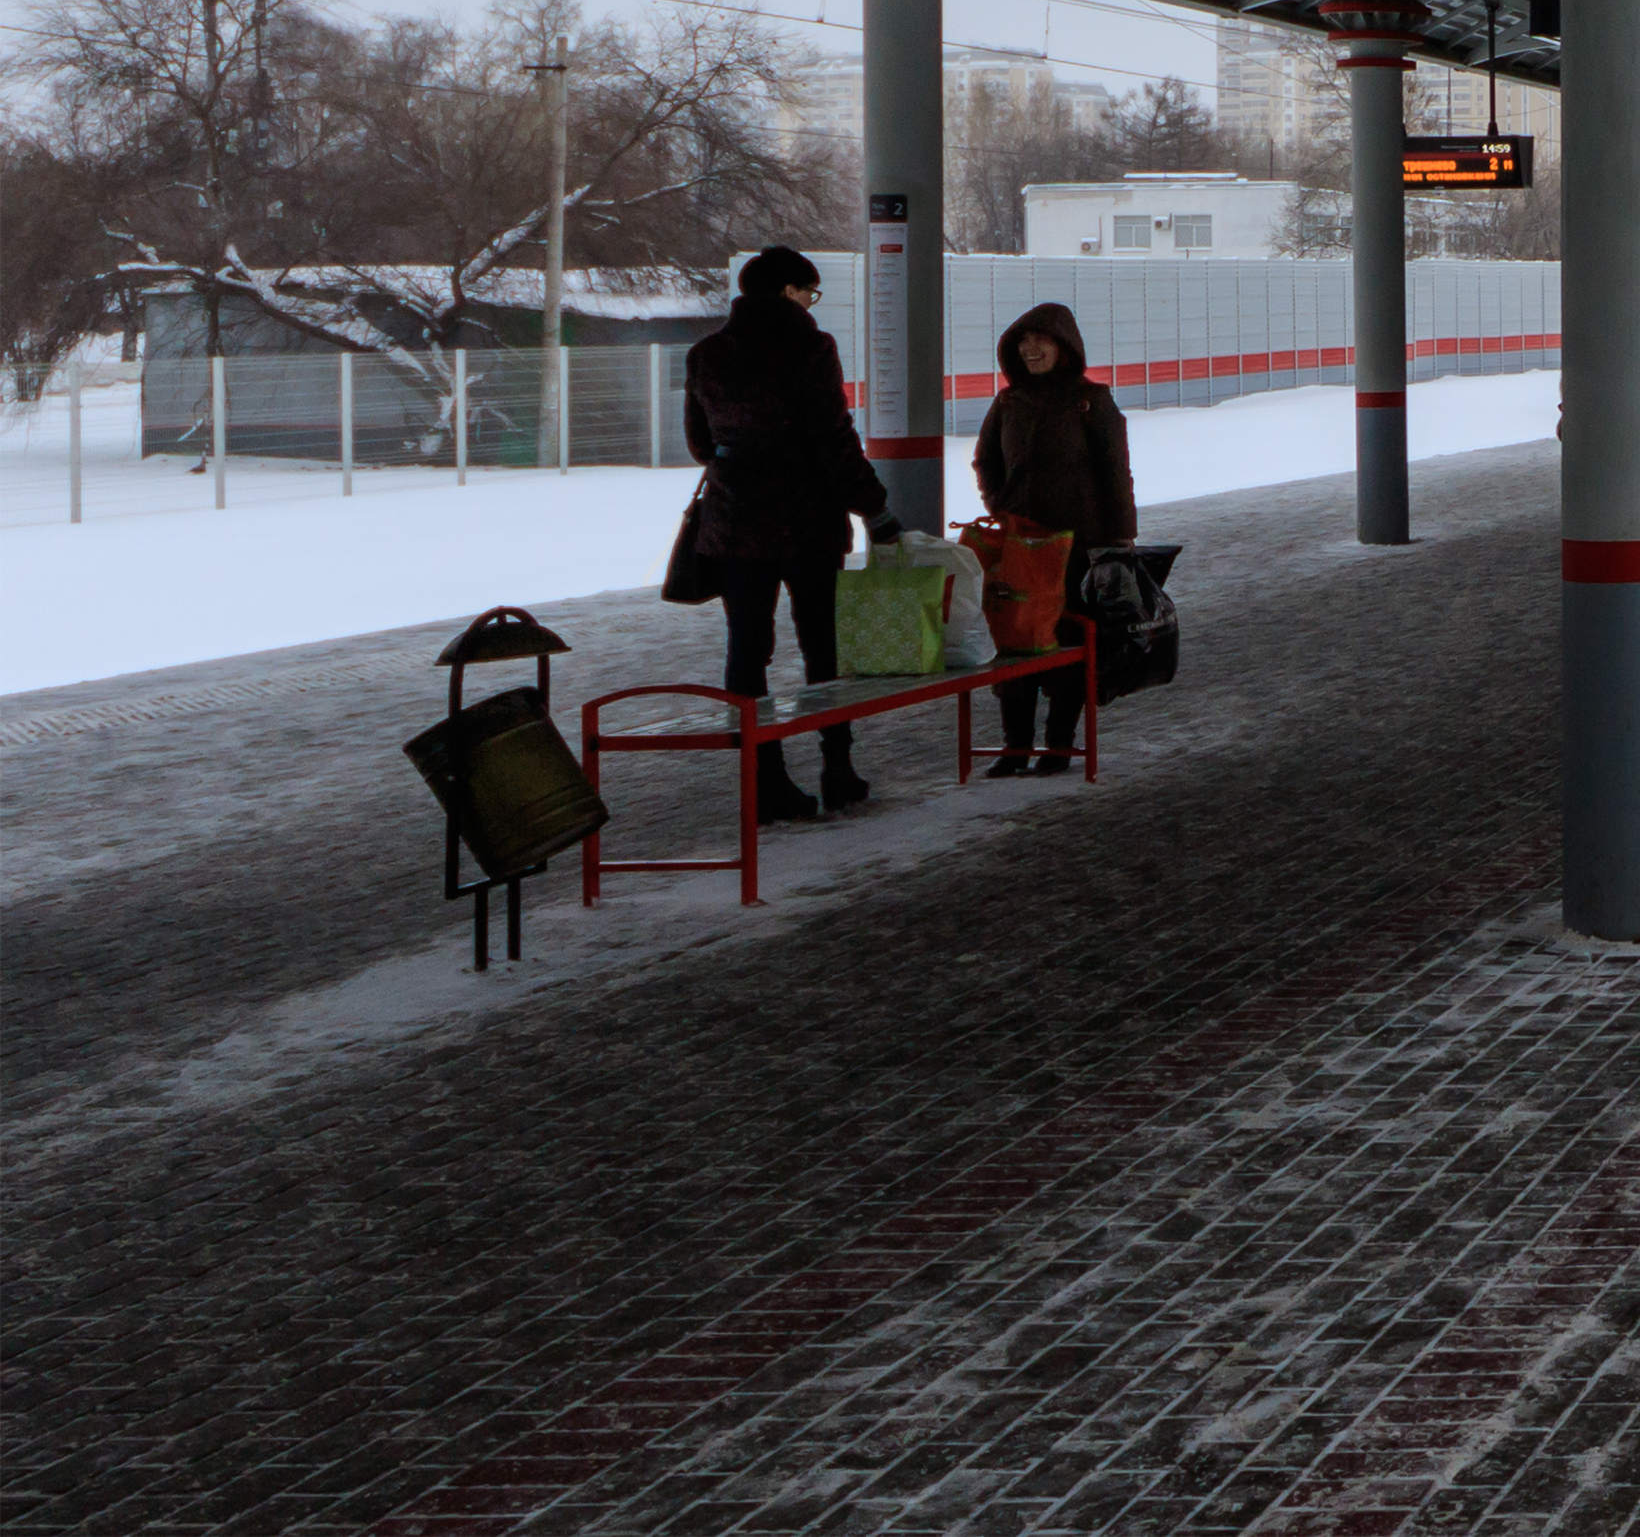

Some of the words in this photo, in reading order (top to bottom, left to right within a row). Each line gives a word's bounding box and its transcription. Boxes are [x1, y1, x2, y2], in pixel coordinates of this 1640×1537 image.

[1482, 144, 1511, 154] 14:59
[1490, 157, 1498, 171] 2
[1426, 173, 1496, 181] остановками
[893, 202, 904, 216] 2
